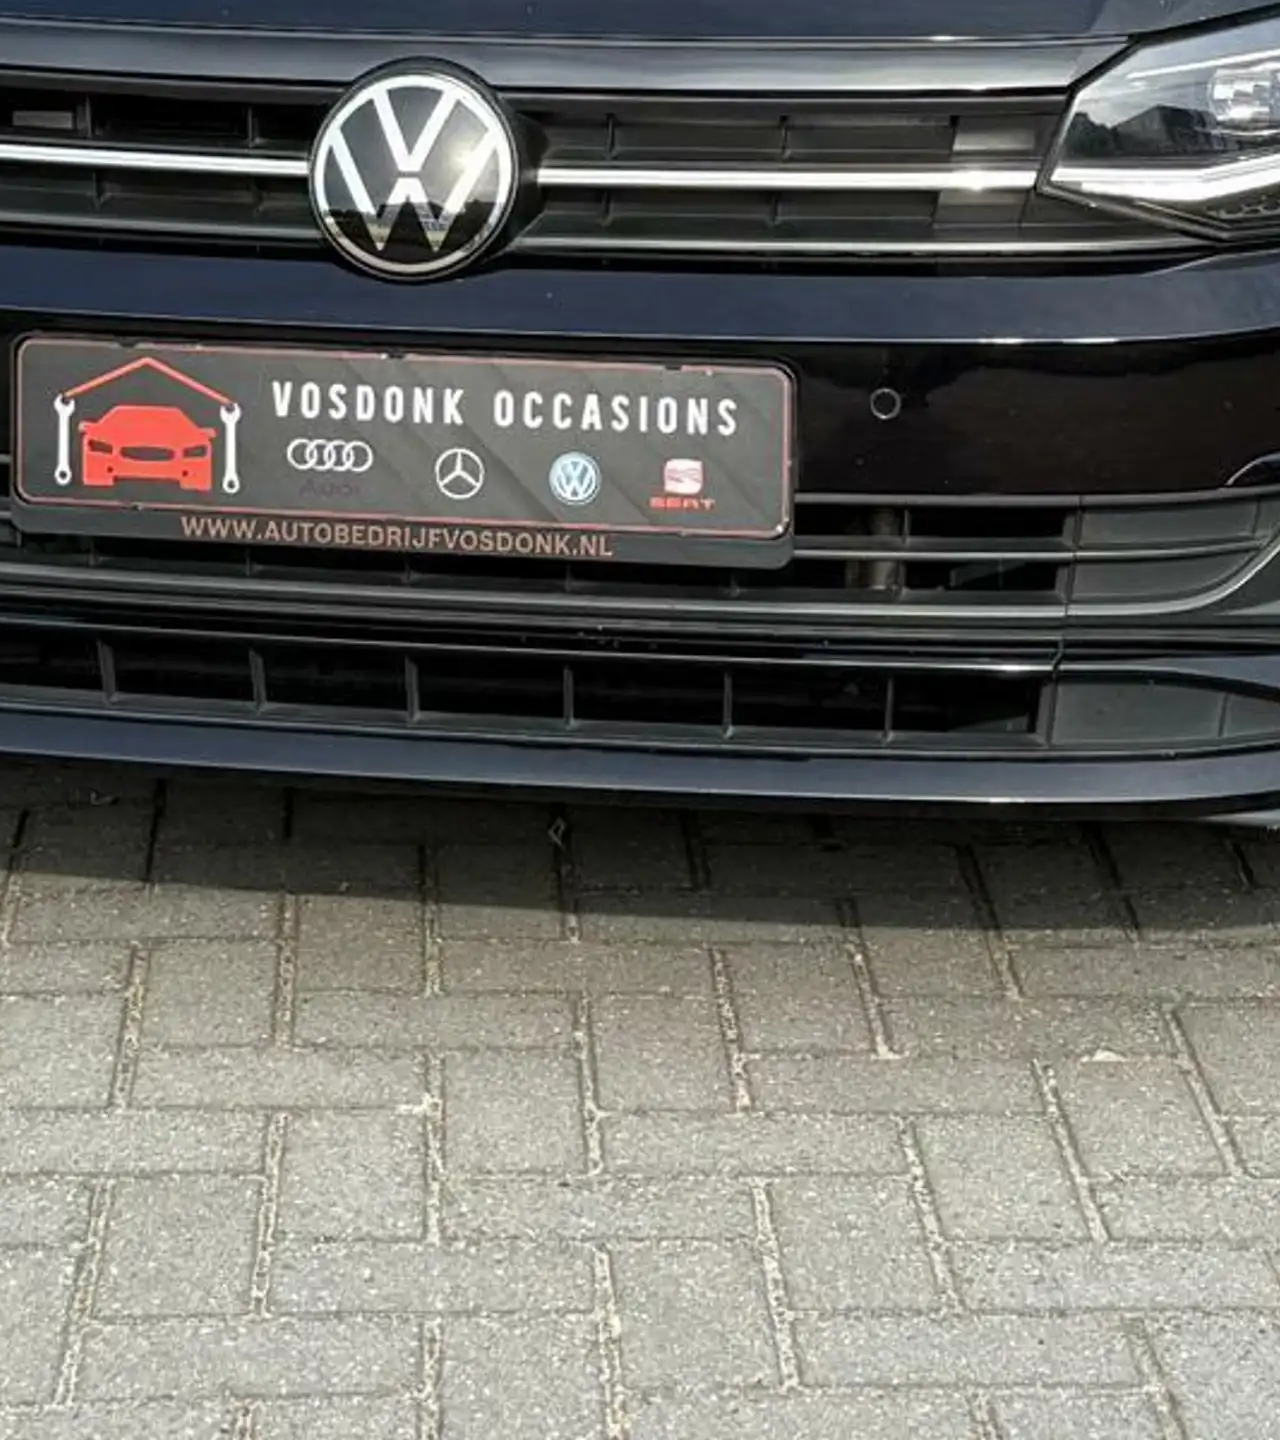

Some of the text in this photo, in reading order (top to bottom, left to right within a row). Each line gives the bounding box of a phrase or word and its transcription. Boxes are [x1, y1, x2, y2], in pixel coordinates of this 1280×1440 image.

[271, 379, 739, 436] VOSDONK OCCASIONS
[180, 515, 613, 558] WWW.AUTOBEDRIJFVOSDONK.NL
